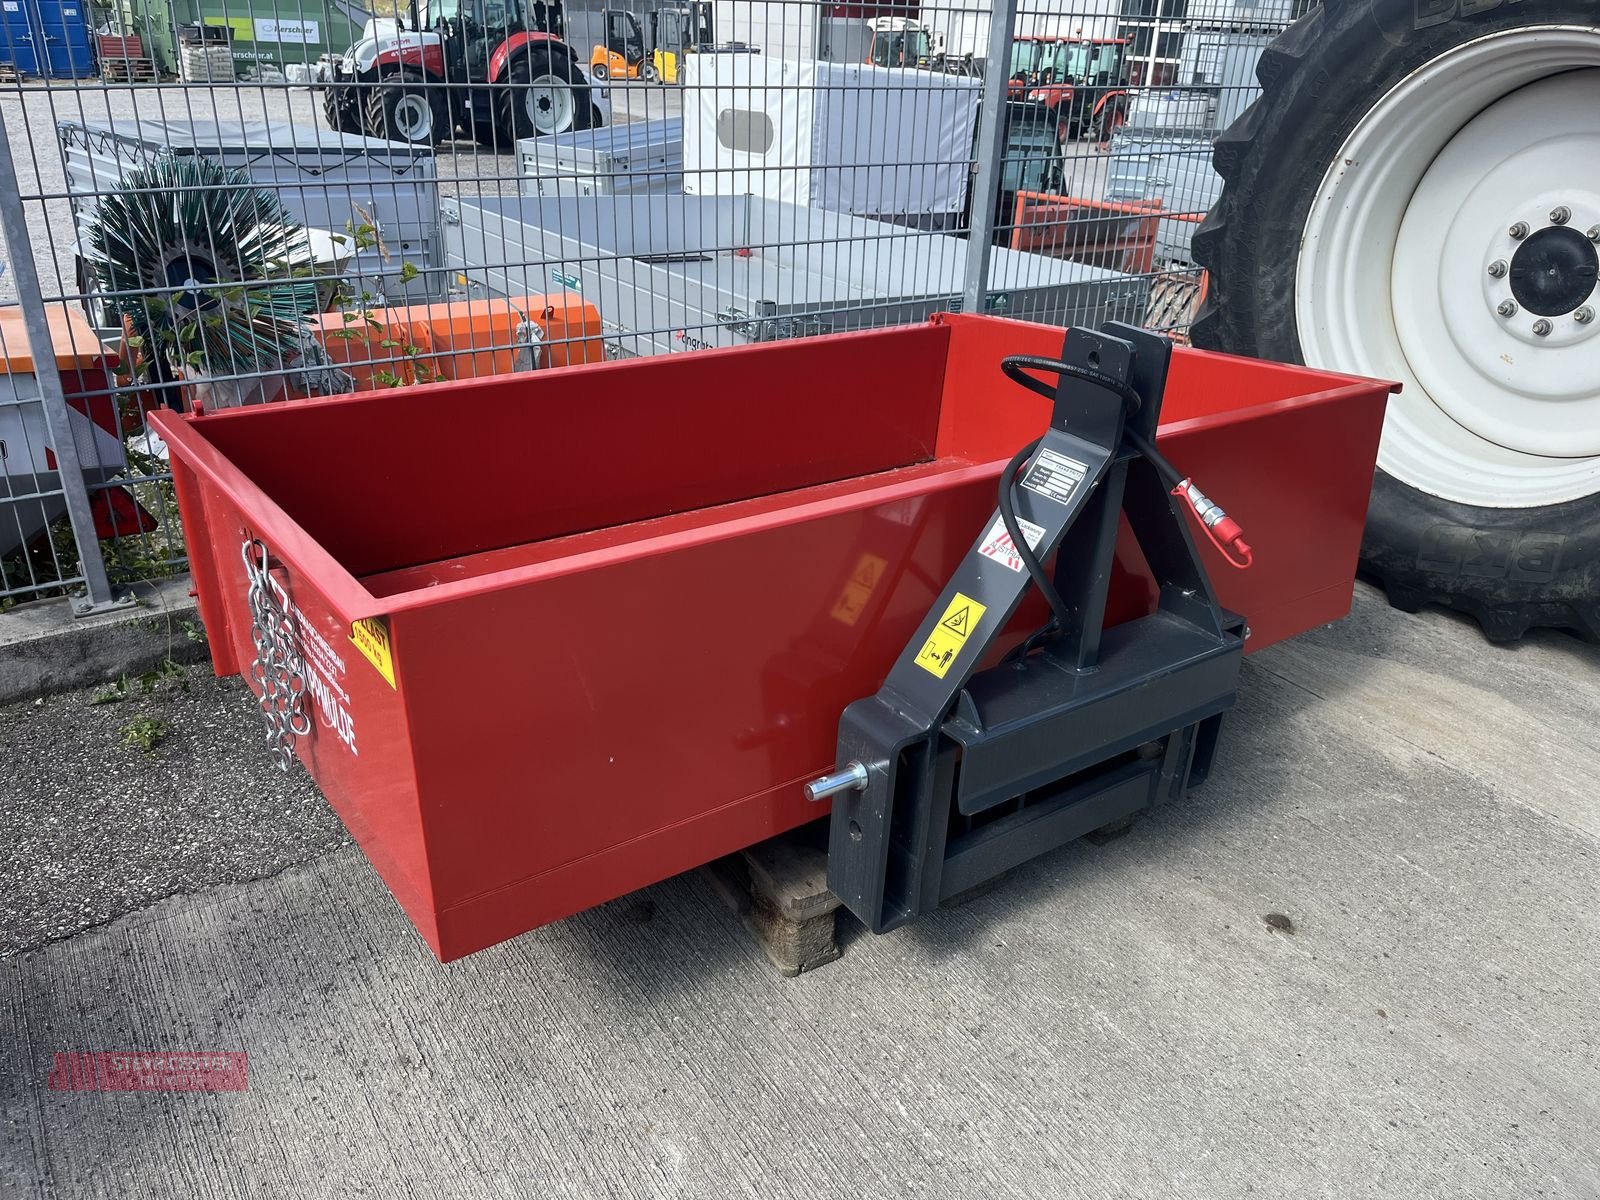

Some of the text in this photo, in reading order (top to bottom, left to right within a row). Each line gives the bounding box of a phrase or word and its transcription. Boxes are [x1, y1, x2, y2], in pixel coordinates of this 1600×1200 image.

[274, 25, 314, 34] Kerscher
[990, 541, 1020, 560] AUSTRIA
[300, 656, 359, 757] IPPMULDE
